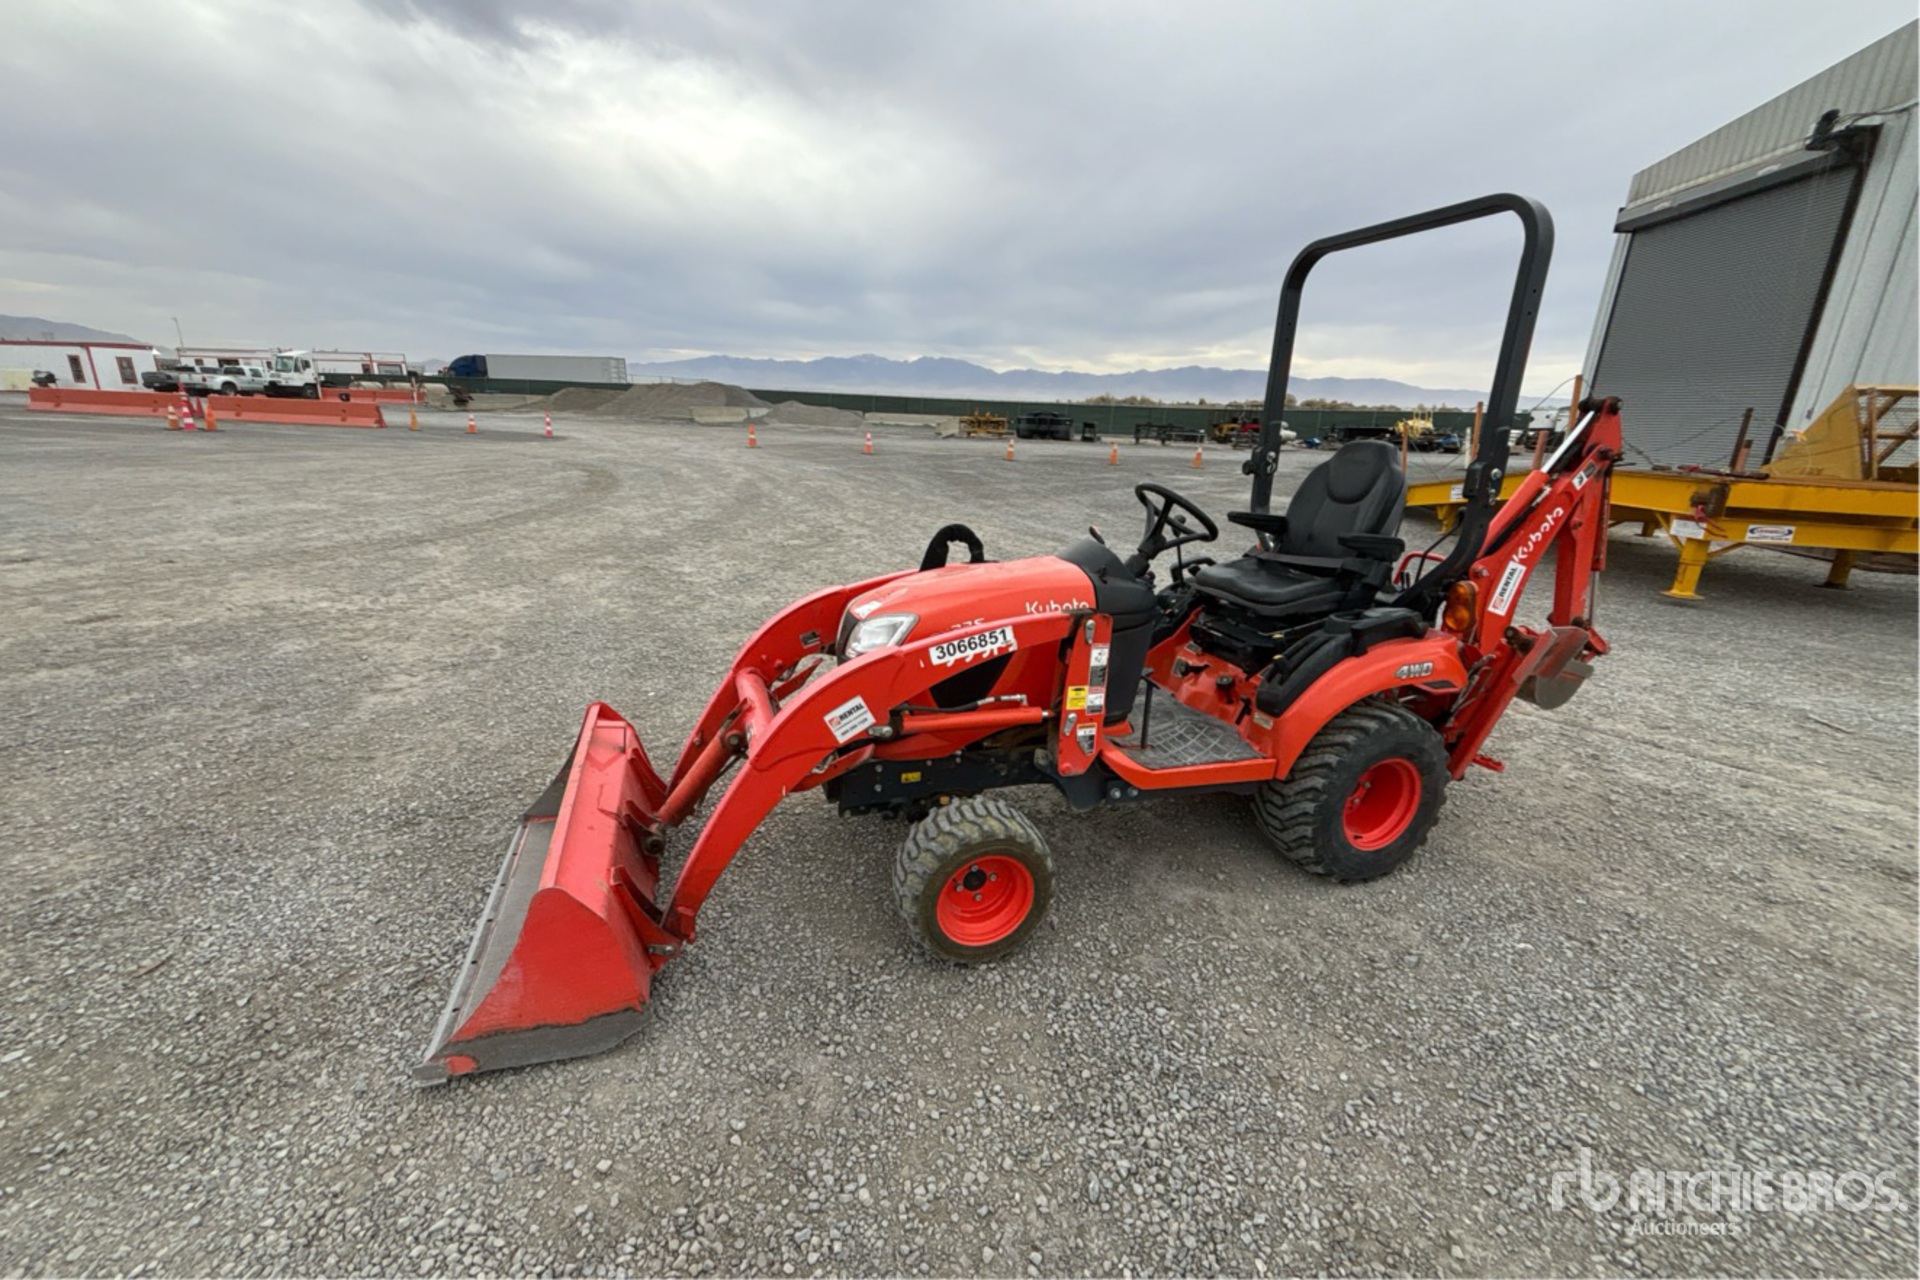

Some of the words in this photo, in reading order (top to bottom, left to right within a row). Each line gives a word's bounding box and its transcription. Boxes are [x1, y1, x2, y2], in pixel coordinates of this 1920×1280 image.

[1511, 507, 1564, 563] Kubota
[1498, 566, 1518, 597] RENTAL
[935, 628, 1009, 660] 3066851
[1396, 662, 1433, 679] 4WD
[838, 703, 865, 721] RENTAL
